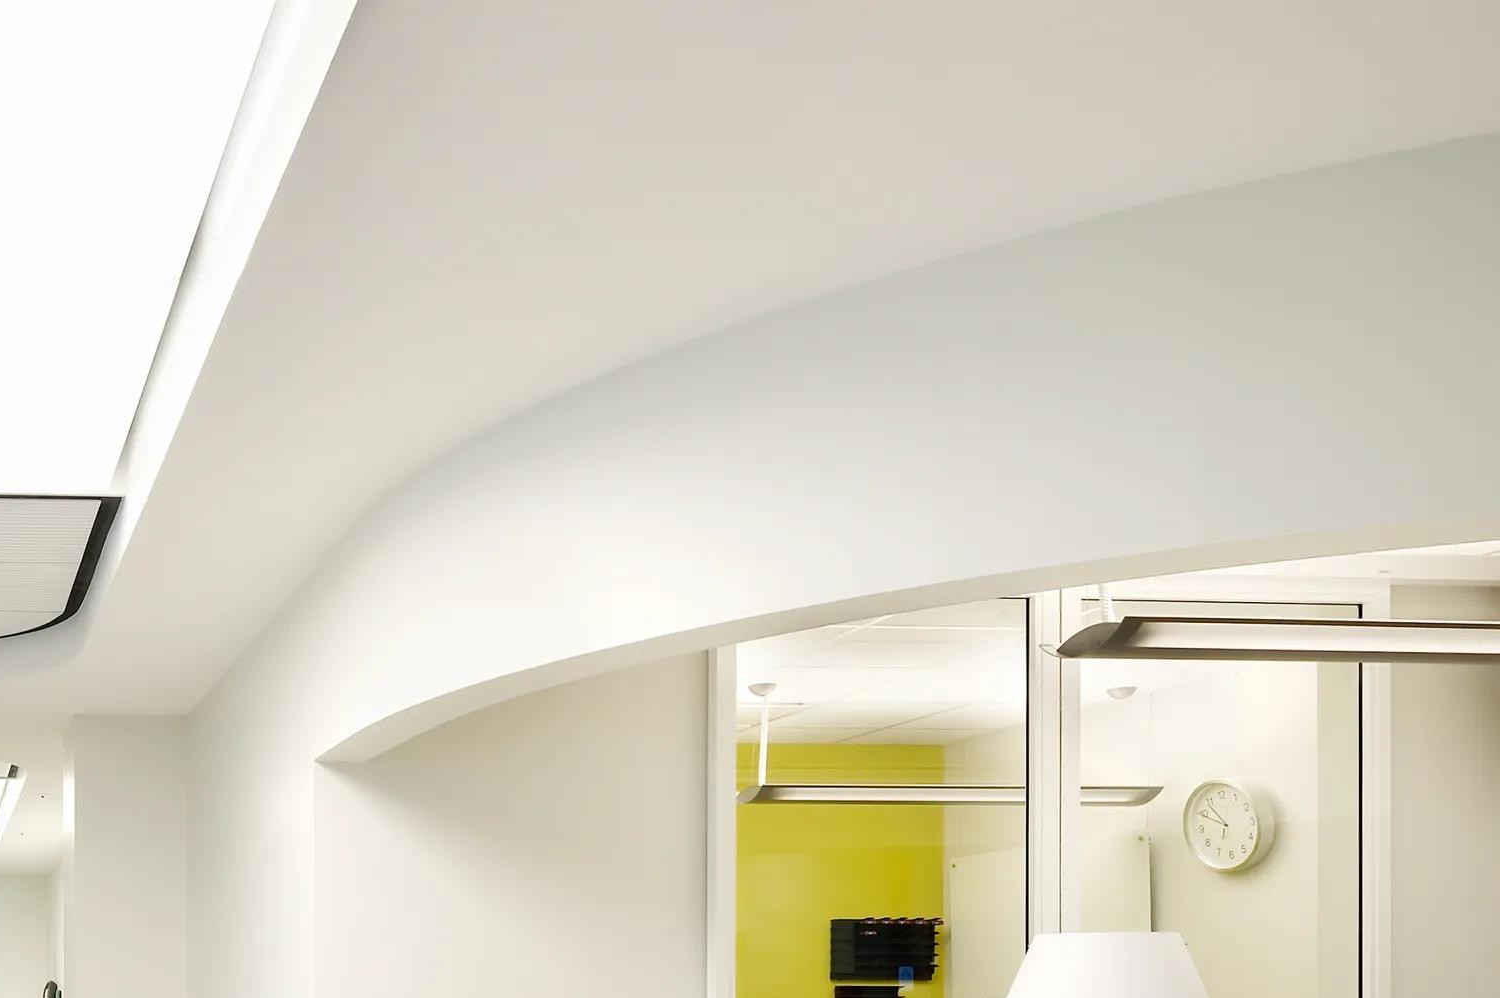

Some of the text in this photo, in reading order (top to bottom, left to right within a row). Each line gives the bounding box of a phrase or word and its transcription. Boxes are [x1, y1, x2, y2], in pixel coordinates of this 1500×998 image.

[1217, 790, 1226, 800] 12
[1243, 802, 1250, 812] 2
[1249, 816, 1256, 826] 3
[1198, 824, 1205, 834] 9
[1205, 838, 1211, 847] 8
[1216, 848, 1221, 857] 7
[1241, 844, 1247, 854] 5
[1229, 850, 1235, 860] 6
